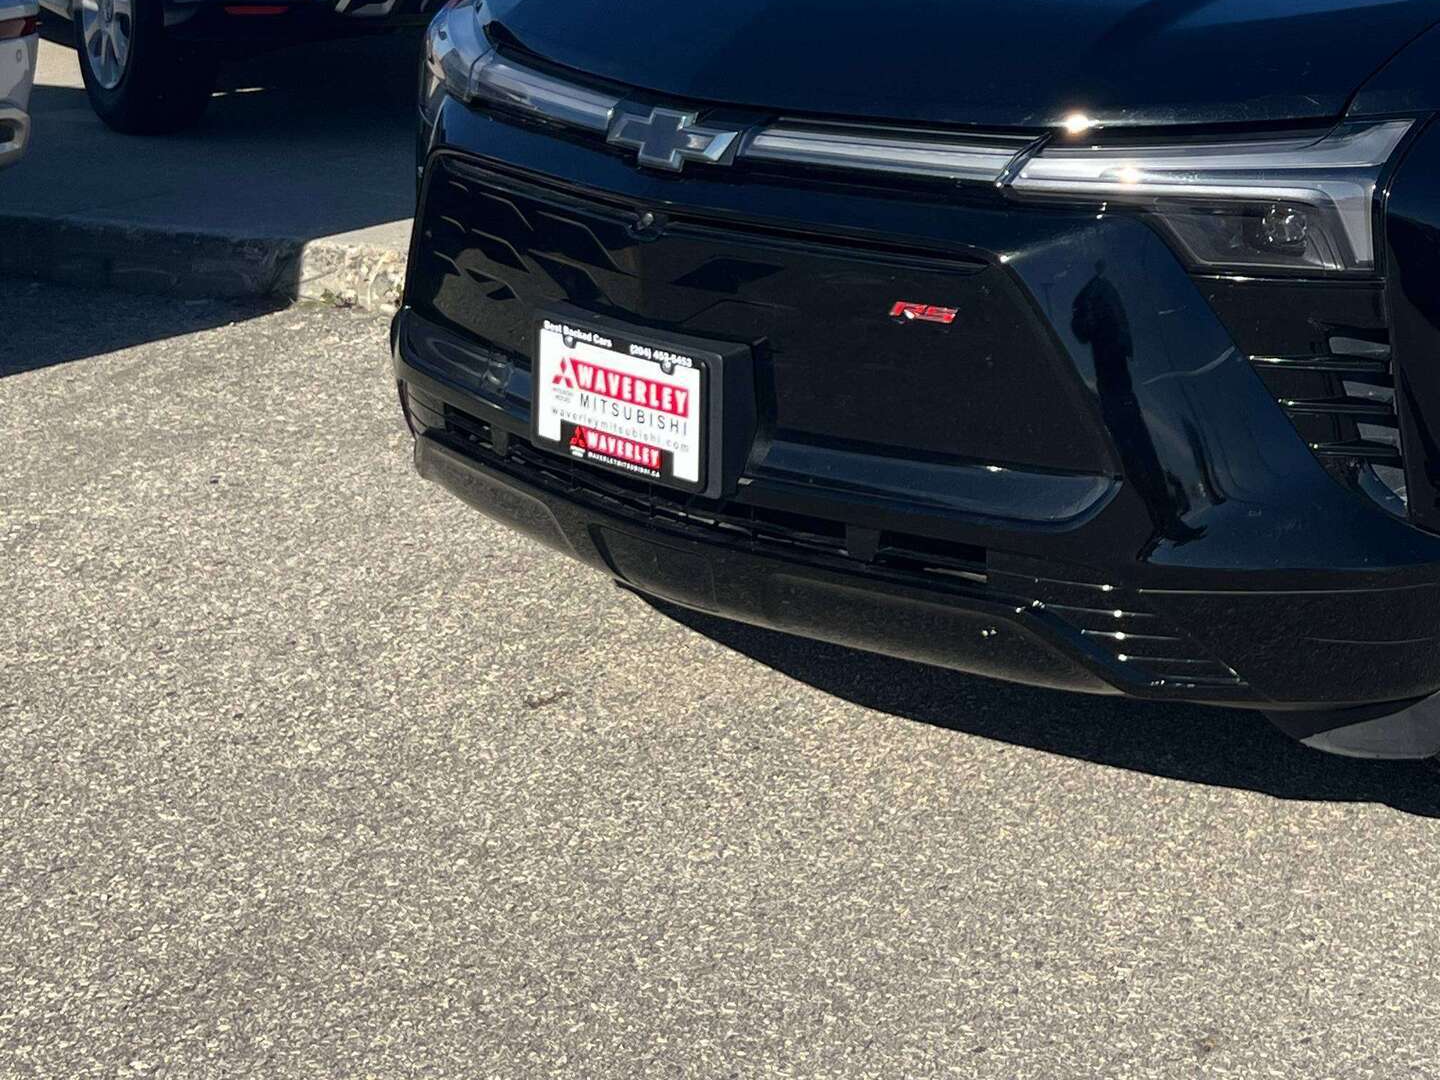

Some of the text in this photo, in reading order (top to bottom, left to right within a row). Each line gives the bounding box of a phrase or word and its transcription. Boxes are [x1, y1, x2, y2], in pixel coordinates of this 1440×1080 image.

[889, 301, 959, 324] RS
[577, 363, 688, 414] WAVERLEY
[580, 393, 688, 437] MITSUBISHI
[587, 430, 660, 467] WAVERLEY
